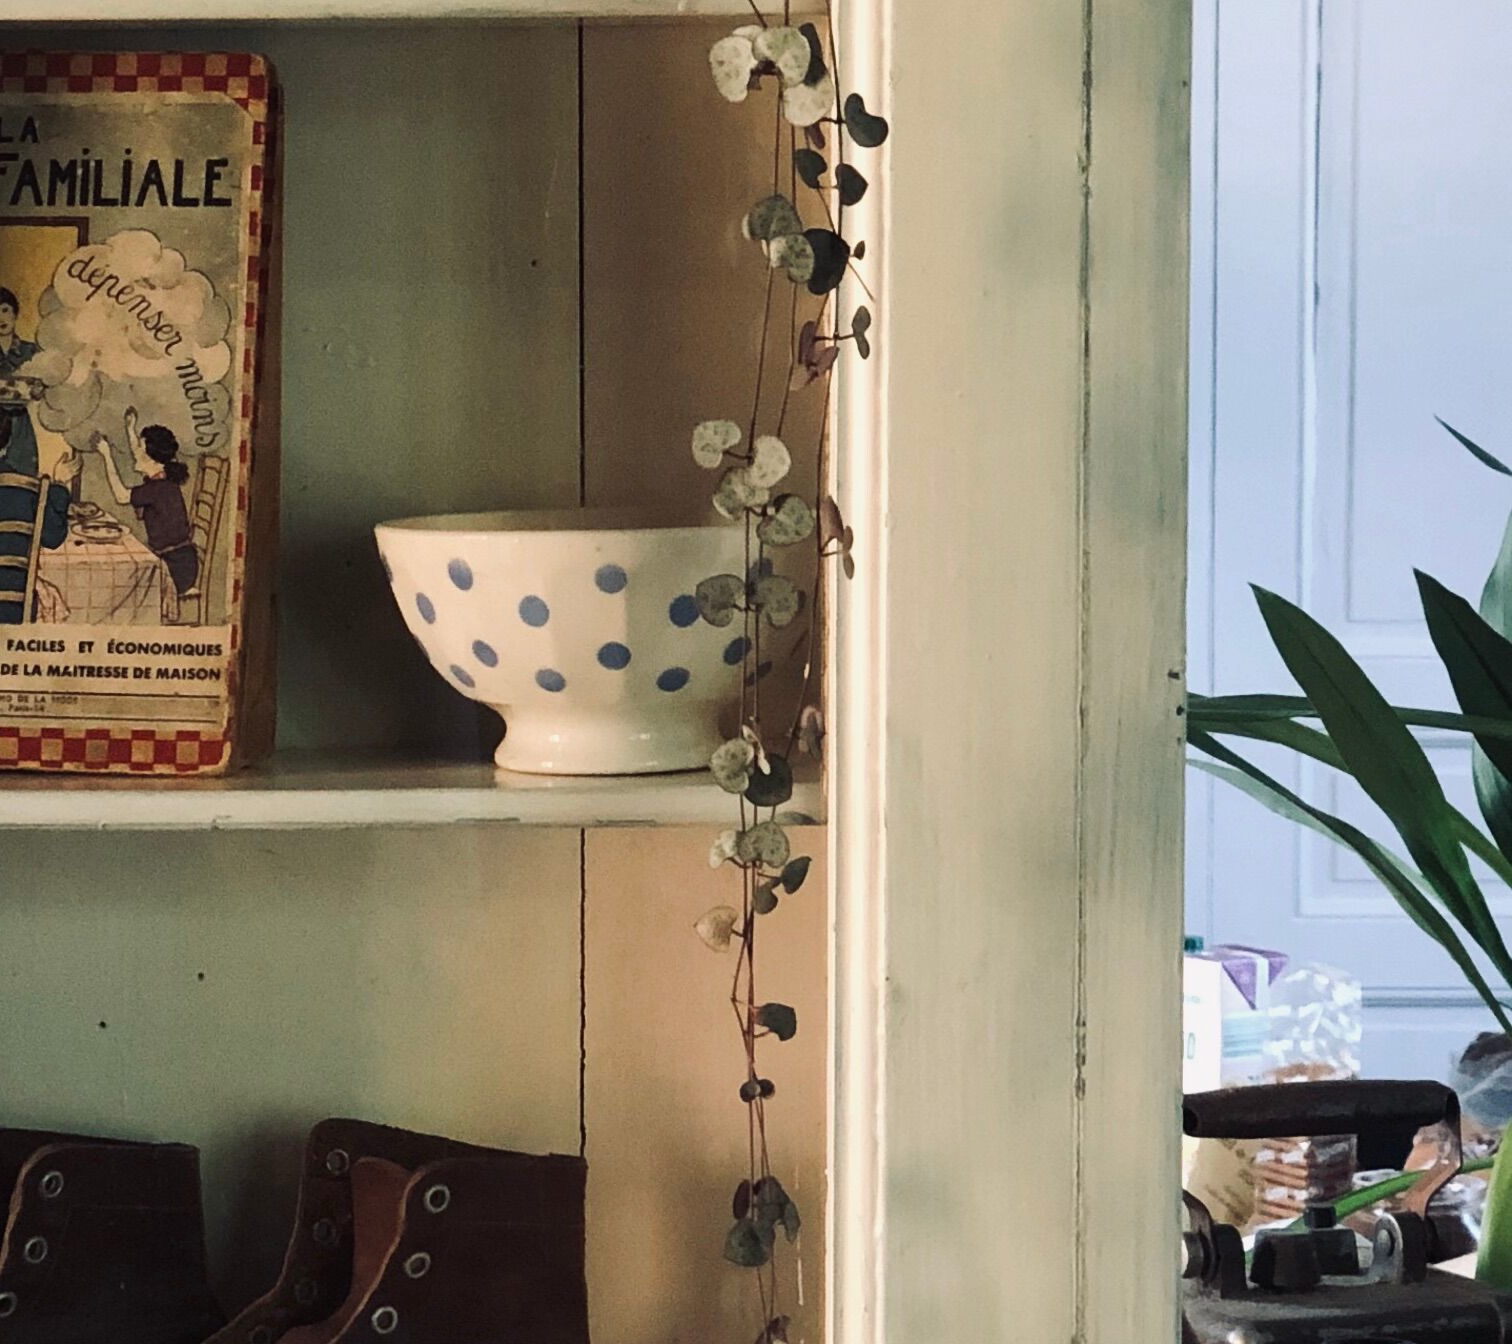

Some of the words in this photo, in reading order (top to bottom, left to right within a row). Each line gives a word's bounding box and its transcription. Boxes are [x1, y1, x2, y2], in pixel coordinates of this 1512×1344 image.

[66, 255, 183, 356] dépenser
[175, 357, 221, 447] moins
[7, 639, 65, 653] FACILES
[79, 640, 94, 654] ET
[107, 638, 222, 656] ÉCONOMIQUES
[0, 663, 18, 676] DE
[23, 664, 42, 677] LA
[133, 667, 151, 679] DE
[156, 668, 221, 681] MAISON
